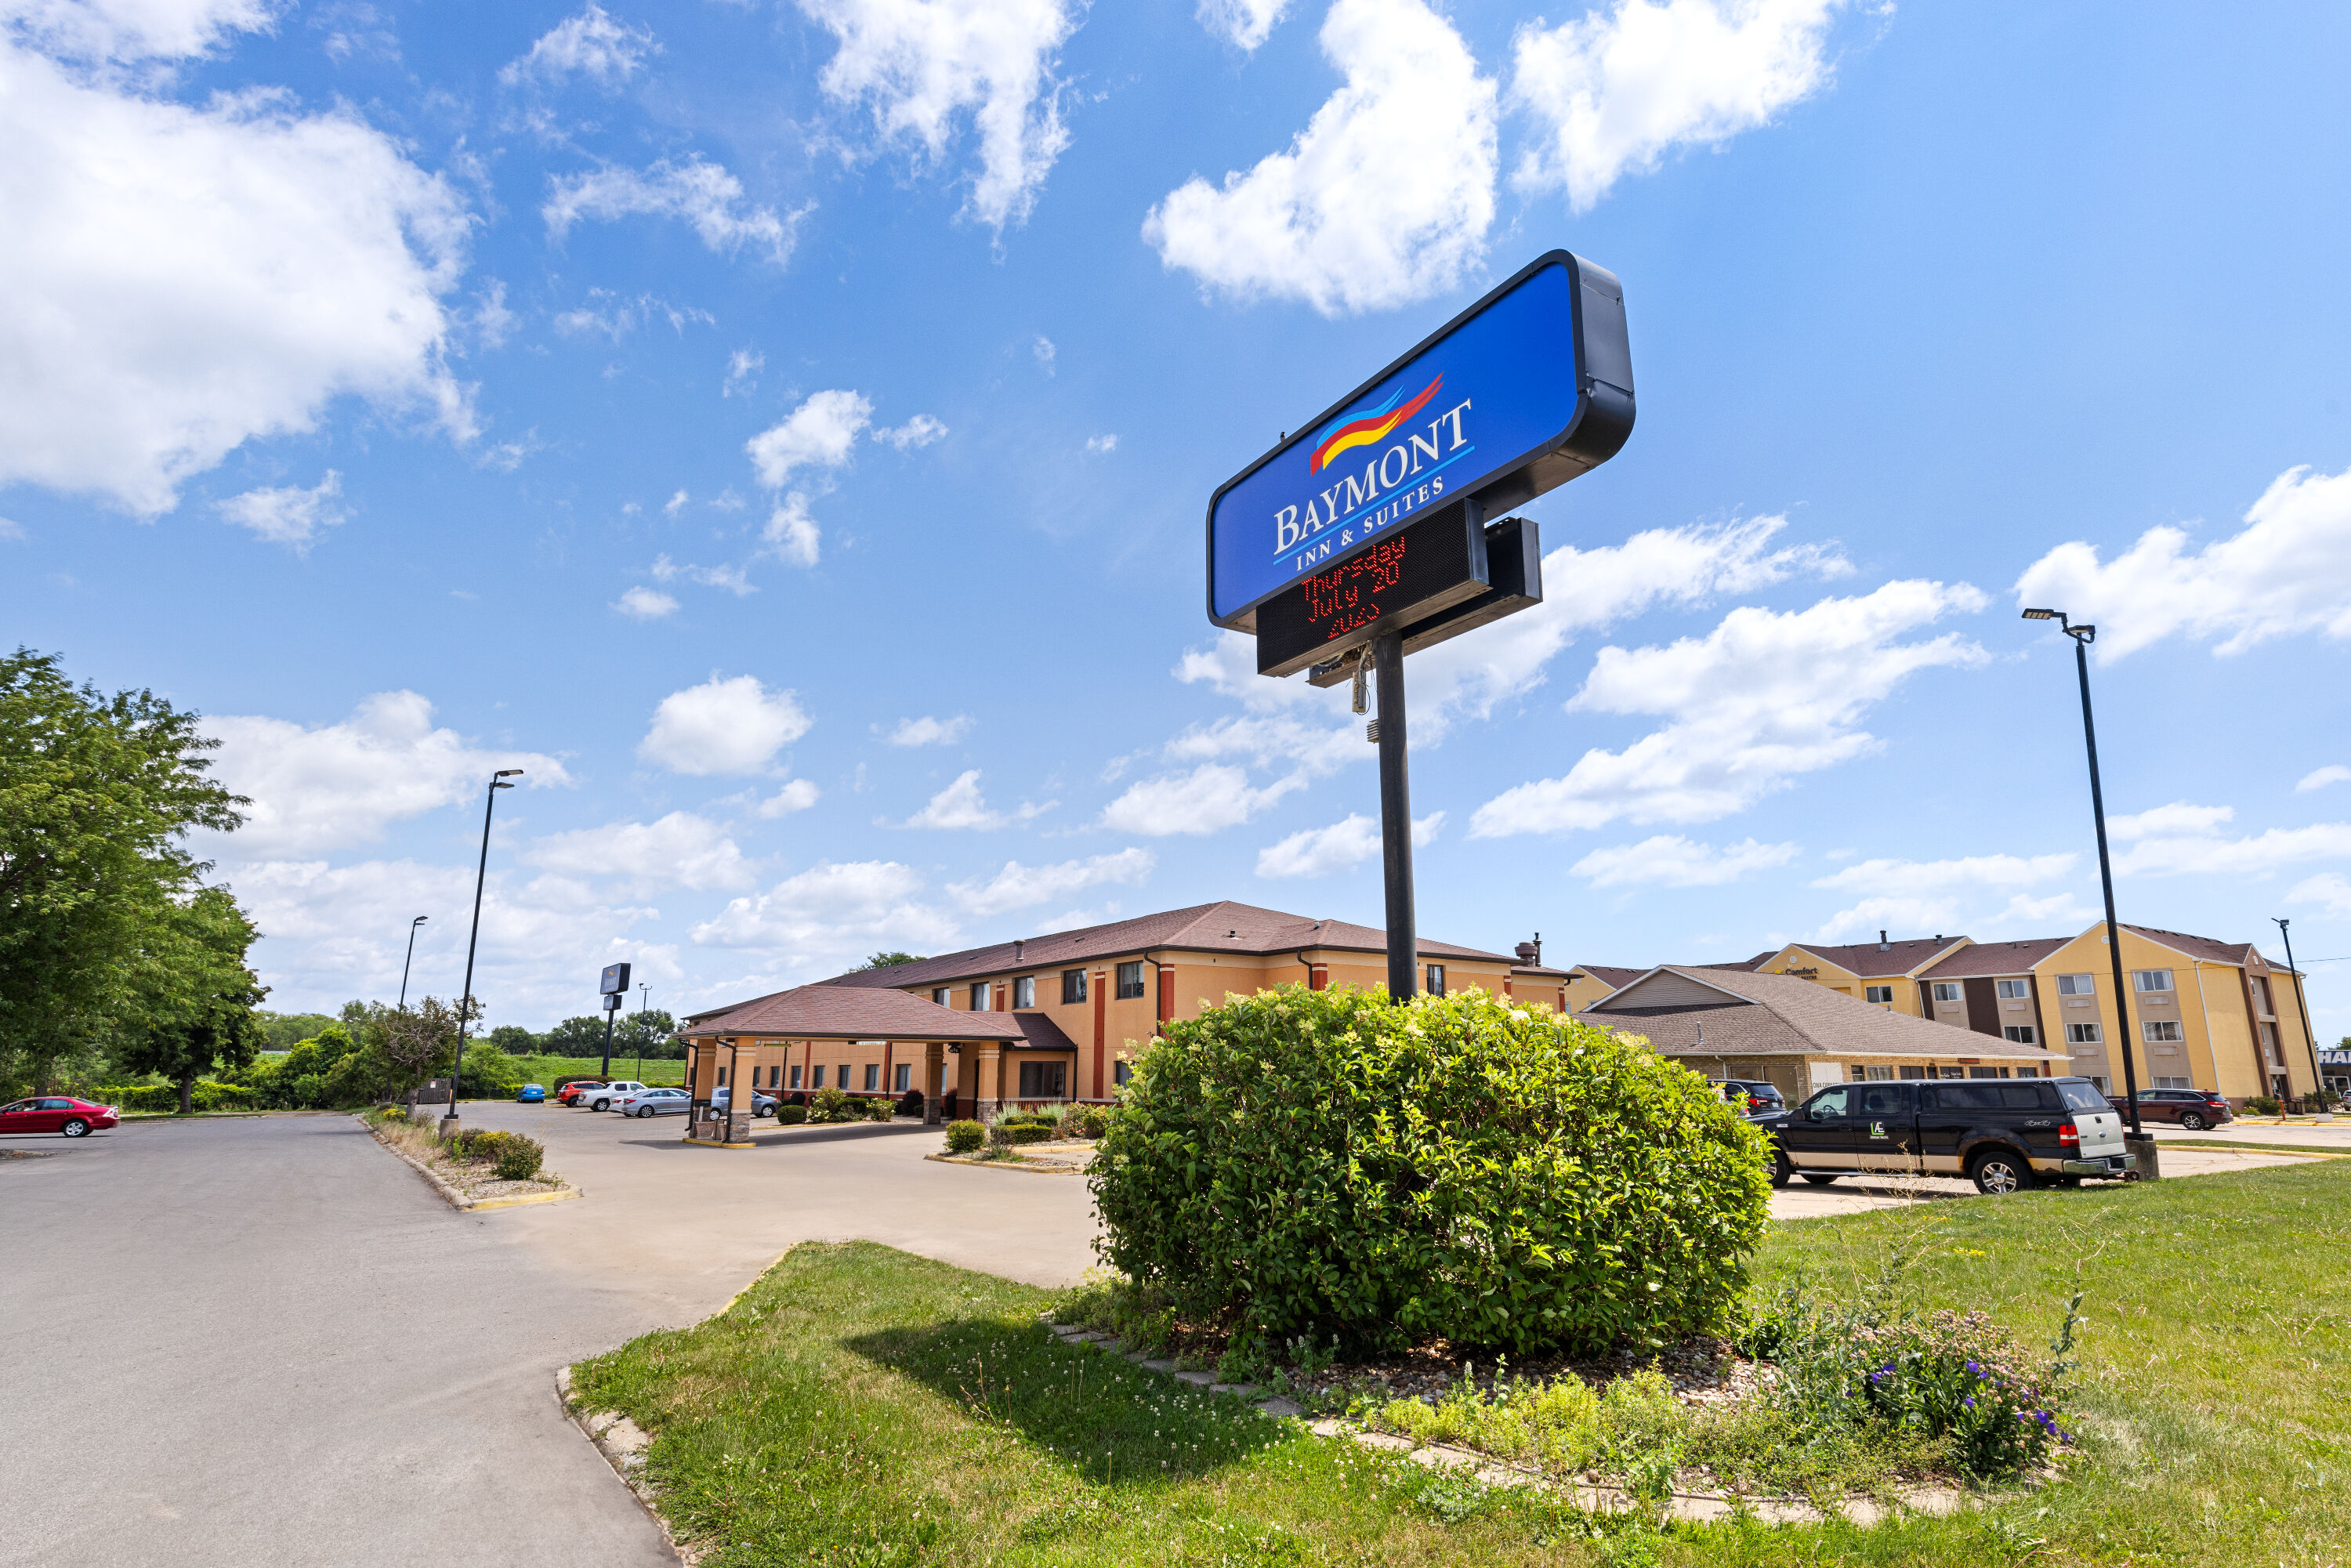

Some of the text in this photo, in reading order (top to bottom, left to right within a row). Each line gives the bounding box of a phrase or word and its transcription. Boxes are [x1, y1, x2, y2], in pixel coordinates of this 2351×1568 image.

[1273, 397, 1472, 556] BAYMONT
[1296, 476, 1444, 571] INN & SUITES
[1301, 536, 1405, 601] Thursday
[1308, 560, 1400, 623] July 20
